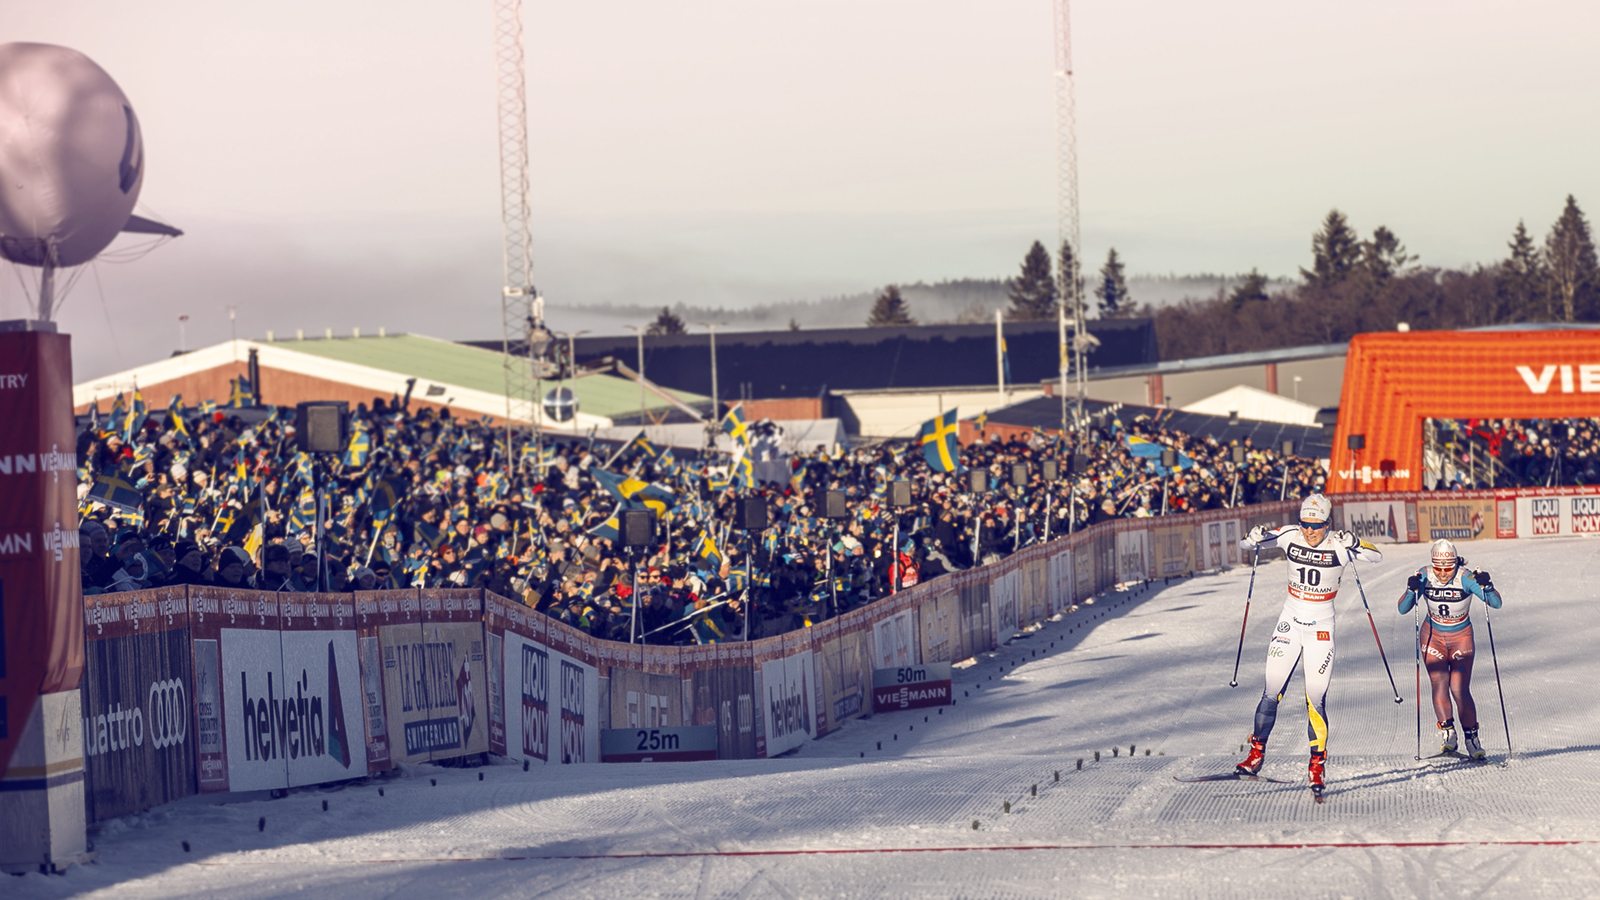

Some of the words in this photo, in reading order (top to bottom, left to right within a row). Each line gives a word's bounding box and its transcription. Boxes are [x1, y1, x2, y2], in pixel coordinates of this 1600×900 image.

[1515, 364, 1600, 393] VIE
[1429, 506, 1438, 527] LE
[1533, 500, 1559, 517] LIQUI
[1533, 516, 1560, 534] MOLY
[1290, 546, 1333, 562] GUIDE
[1296, 567, 1321, 587] 10
[1438, 604, 1450, 617] 8
[1318, 652, 1333, 674] CRAFT
[523, 648, 549, 702] LIQUI
[897, 667, 926, 683] 50m
[878, 687, 946, 708] VIESSMANN
[241, 668, 326, 762] helvetia
[770, 680, 802, 739] helvetia
[407, 722, 459, 750] SWITZERLAND
[523, 704, 549, 756] MOLY
[637, 730, 679, 751] 25m
